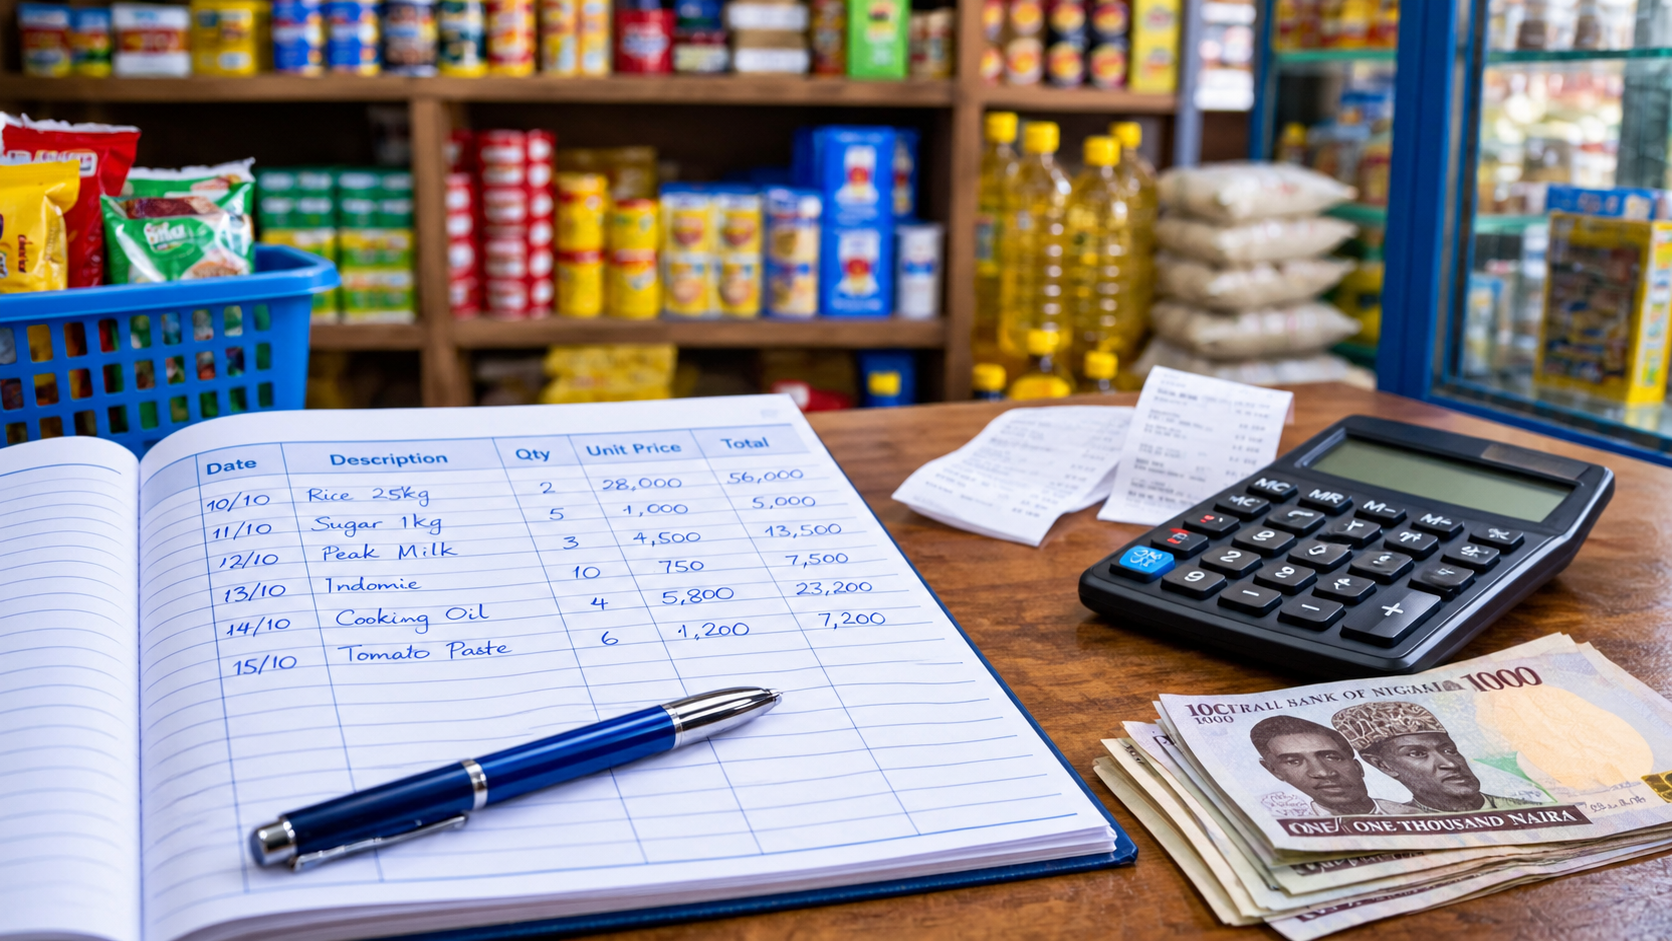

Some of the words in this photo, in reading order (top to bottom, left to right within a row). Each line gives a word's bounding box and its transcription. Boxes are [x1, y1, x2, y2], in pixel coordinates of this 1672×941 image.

[206, 458, 257, 475] Date
[329, 453, 448, 468] Description
[515, 448, 550, 462] Qty
[586, 444, 629, 457] Unit
[633, 442, 682, 455] Price
[720, 437, 770, 450] Total
[206, 491, 271, 512] 10/10
[307, 488, 354, 502] Rice
[540, 482, 556, 494] 2
[602, 477, 682, 492] 28,000
[727, 469, 804, 485] 56,000
[1309, 489, 1345, 503] MR
[212, 521, 272, 540] 11/10
[311, 516, 383, 537] Sugar
[401, 513, 442, 535] 1kg
[549, 507, 565, 521] 5
[623, 504, 688, 517] 1,000
[752, 495, 816, 510] 5,000
[219, 551, 279, 569] 12/10
[322, 543, 380, 561] Peak
[398, 542, 458, 560] Milk
[563, 536, 579, 550] 3
[633, 531, 701, 547] 4,500
[764, 523, 842, 538] 13,500
[1219, 550, 1242, 562] 2
[224, 582, 286, 603] 13/10
[325, 577, 422, 593] Indomie
[572, 565, 601, 579] 10
[658, 559, 705, 574] 750
[785, 552, 849, 568] 7,500
[226, 616, 291, 637] 14/10
[335, 608, 429, 634] Cooking
[445, 604, 490, 620] Oil
[590, 597, 609, 611] 4
[662, 586, 735, 606] 5,800
[795, 581, 873, 596] 23,200
[232, 655, 297, 675] 15/10
[337, 644, 430, 662] Tomato
[446, 640, 512, 659] Paste
[601, 630, 619, 646] 6
[677, 622, 750, 640] 1,200
[818, 611, 886, 630] 7,200
[1287, 692, 1339, 707] BANK
[1343, 689, 1366, 701] OF
[1460, 666, 1543, 692] 1000
[1353, 820, 1397, 833] ONE
[1397, 813, 1505, 832] THOUSAND
[1507, 809, 1577, 826] NAIRA
